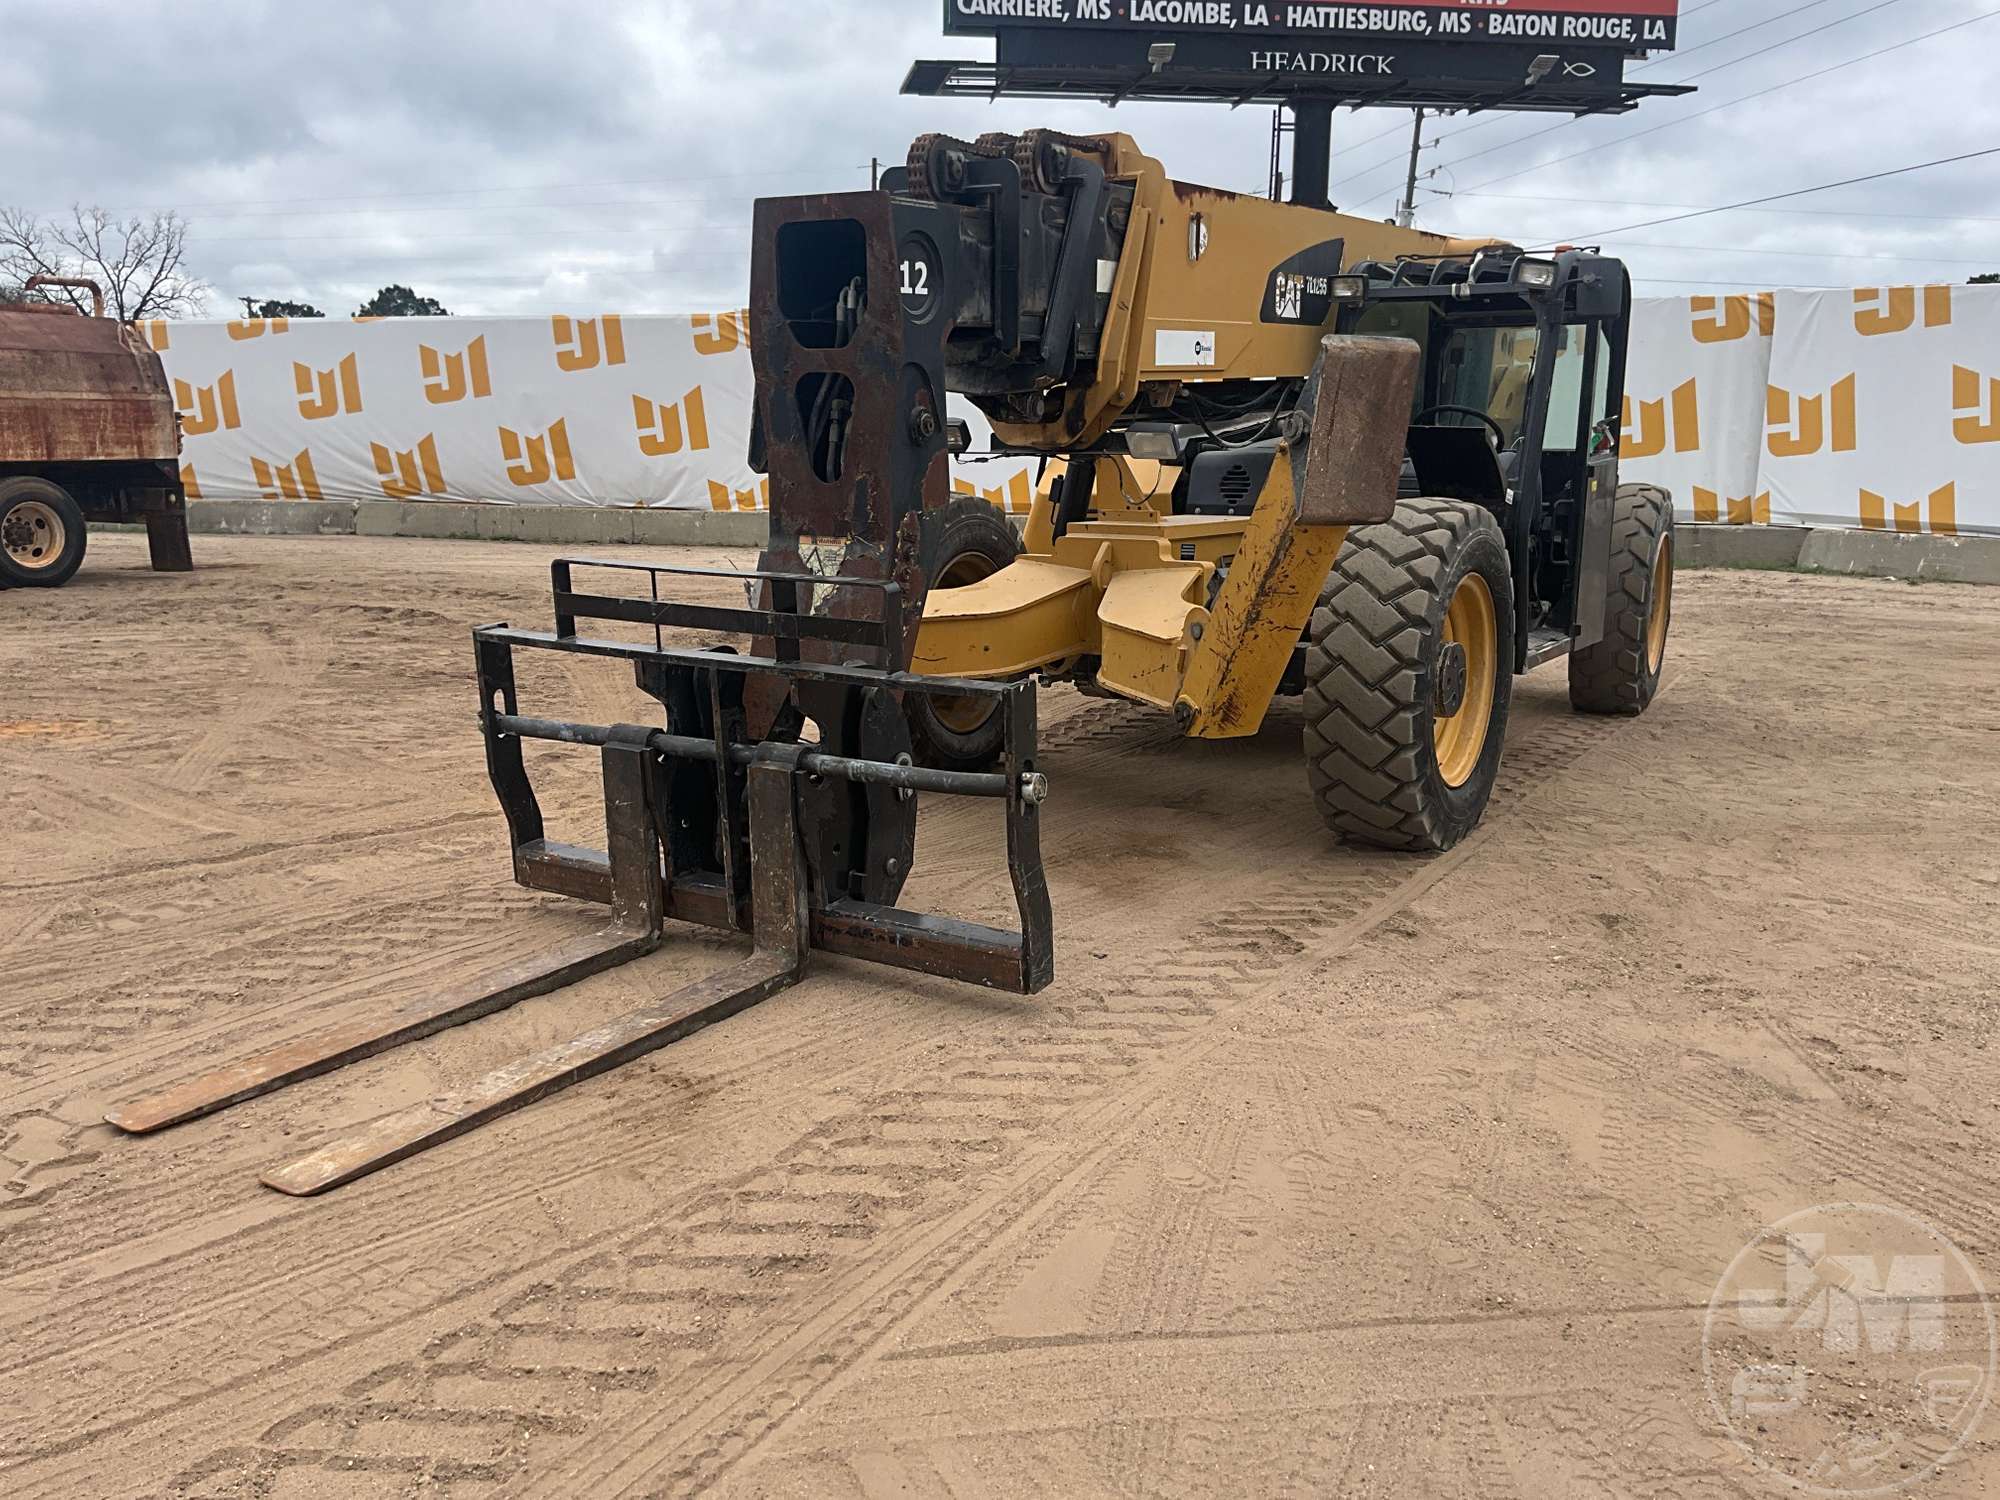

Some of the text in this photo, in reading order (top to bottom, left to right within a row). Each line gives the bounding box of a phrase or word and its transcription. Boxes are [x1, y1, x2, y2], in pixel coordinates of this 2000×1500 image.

[957, 0, 1667, 43] CARRIERE, MS LACOMBE, LA HATTIESBURG, MS BATON ROUGE, LA
[1250, 51, 1396, 74] HEADRICK
[899, 260, 928, 294] 12
[1275, 271, 1304, 319] CAT
